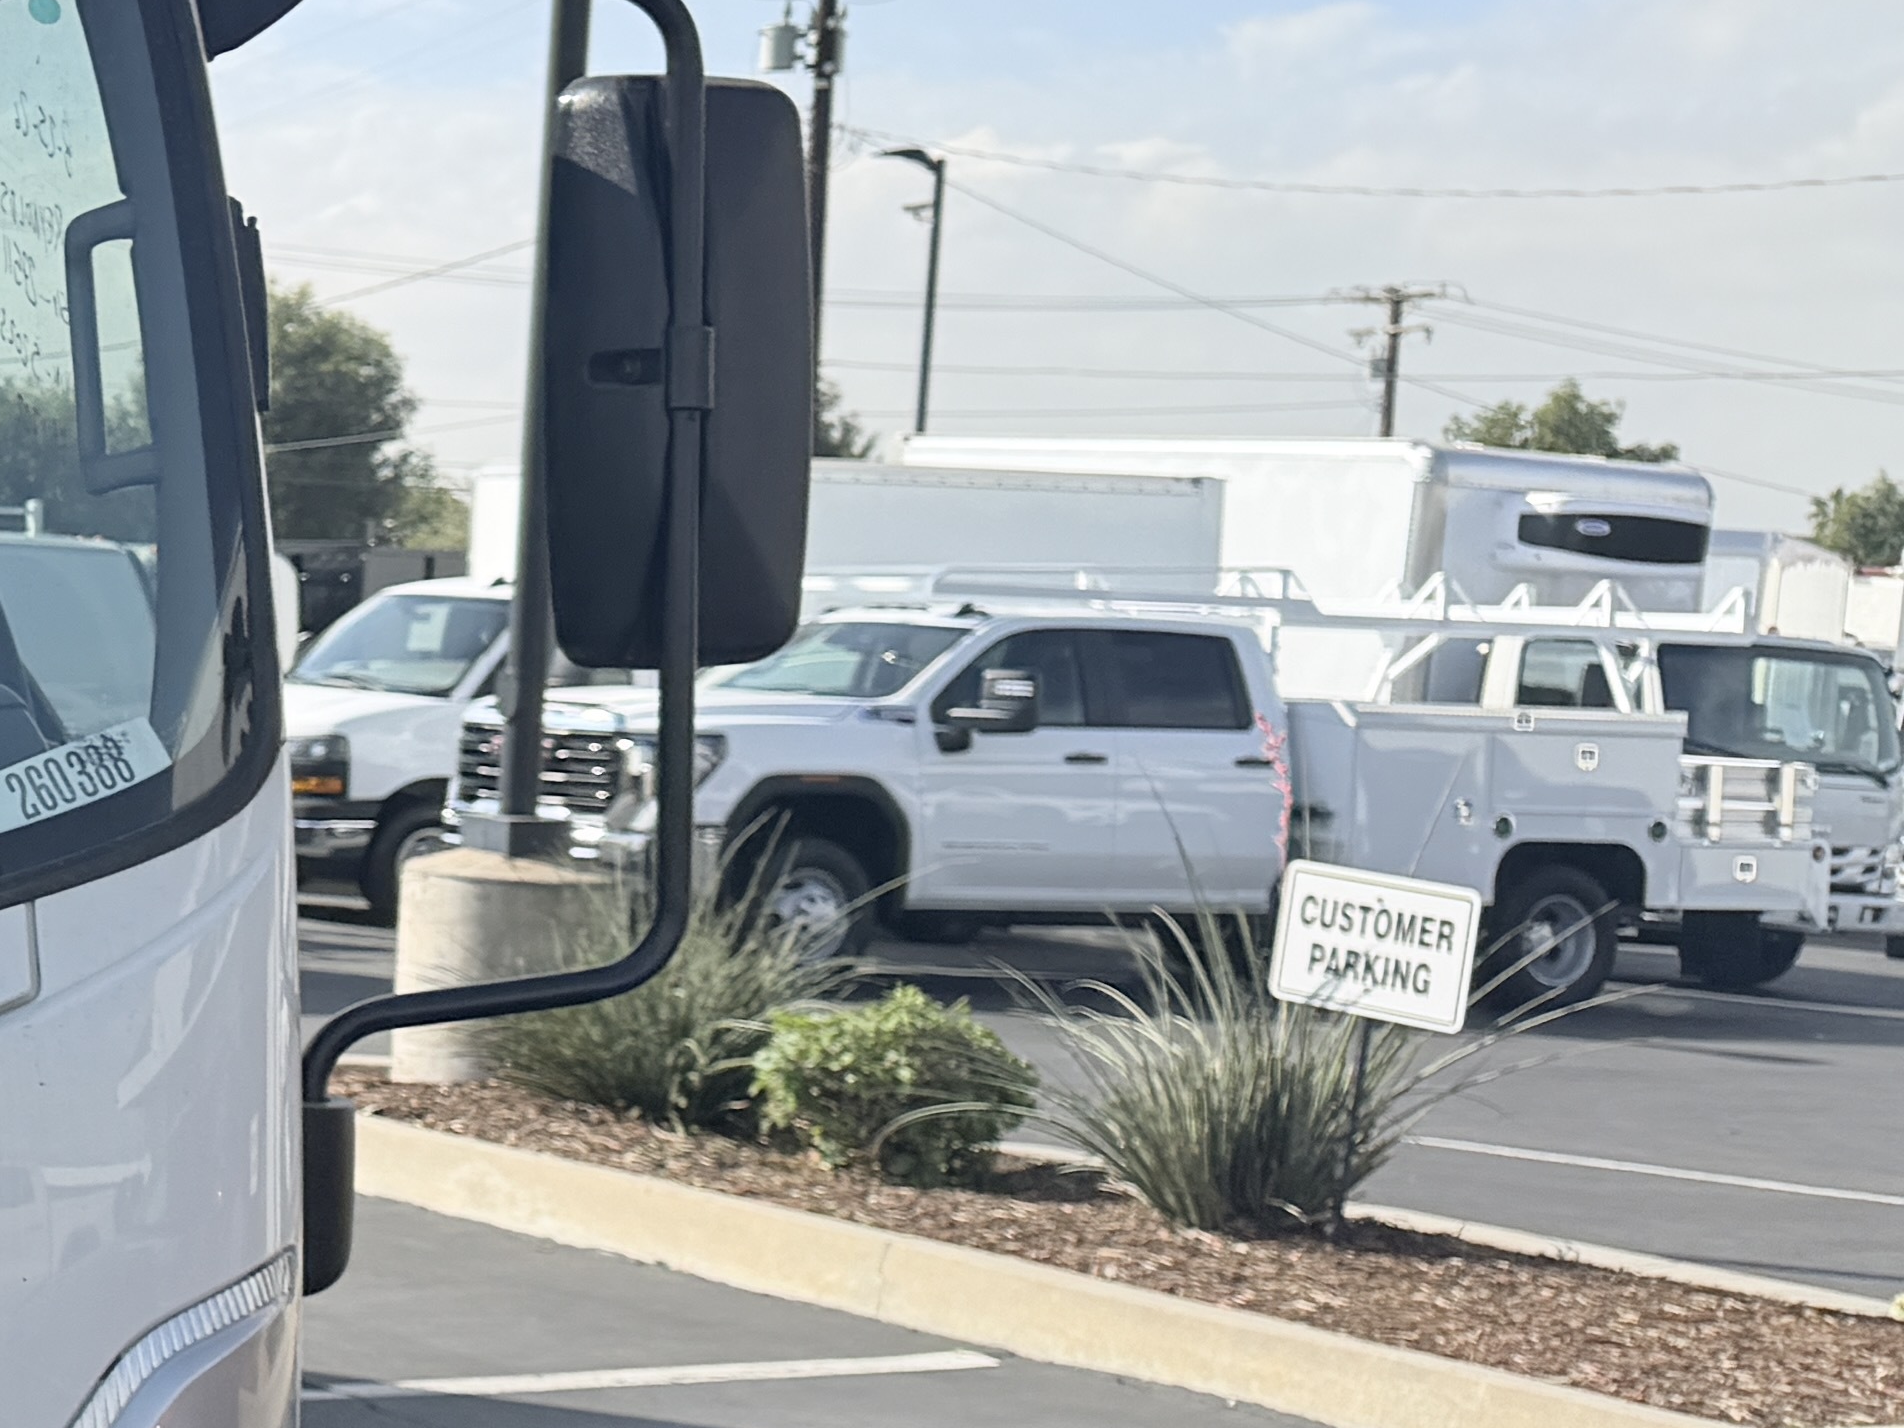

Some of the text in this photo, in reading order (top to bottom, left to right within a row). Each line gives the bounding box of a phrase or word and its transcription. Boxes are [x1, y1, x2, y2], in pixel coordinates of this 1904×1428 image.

[5, 734, 135, 820] 260388
[1301, 894, 1456, 955] CUSTOMER
[1308, 942, 1433, 996] PARKING
